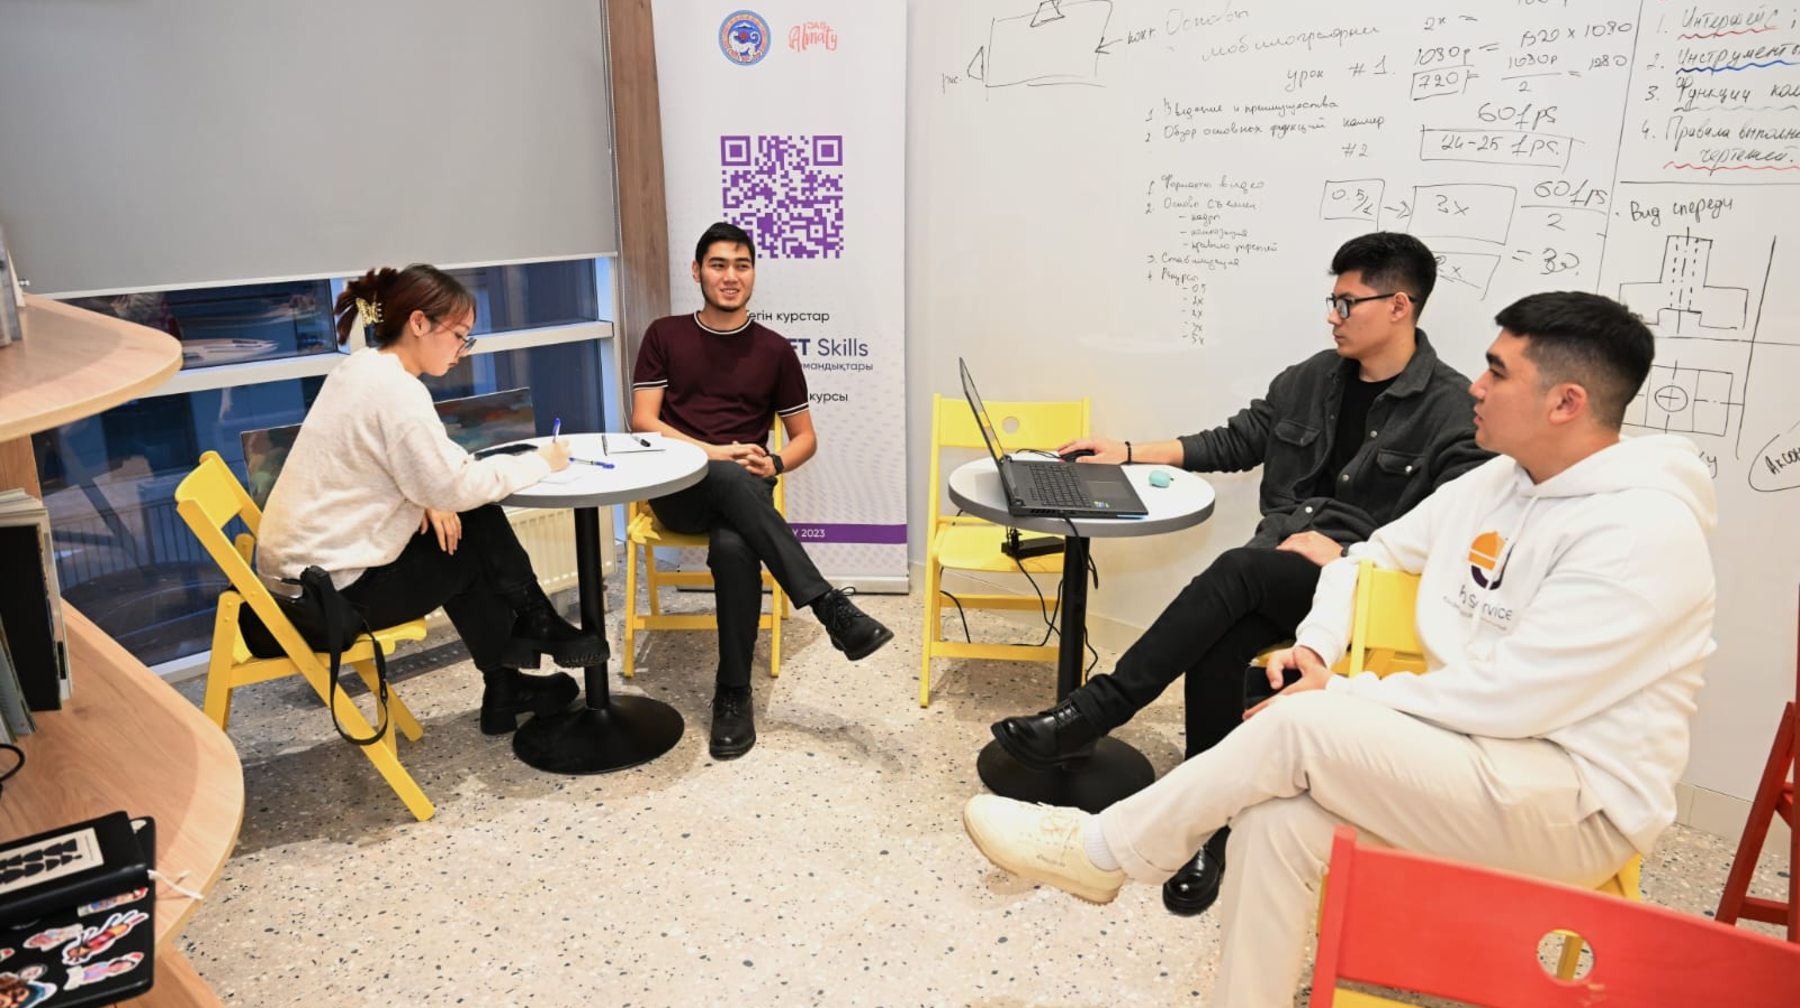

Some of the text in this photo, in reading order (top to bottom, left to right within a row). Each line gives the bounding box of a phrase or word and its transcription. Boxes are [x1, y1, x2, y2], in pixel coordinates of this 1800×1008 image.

[788, 19, 838, 53] Almaty
[1665, 115, 1730, 152] Правила
[1630, 198, 1733, 227] Вид спереди
[1547, 213, 1566, 232] 2
[776, 312, 830, 323] курстар
[817, 338, 869, 357] Skills
[801, 362, 873, 373] мандықтары
[809, 393, 848, 403] курсы
[801, 529, 826, 538] 2023
[1468, 594, 1513, 621] Srvice
